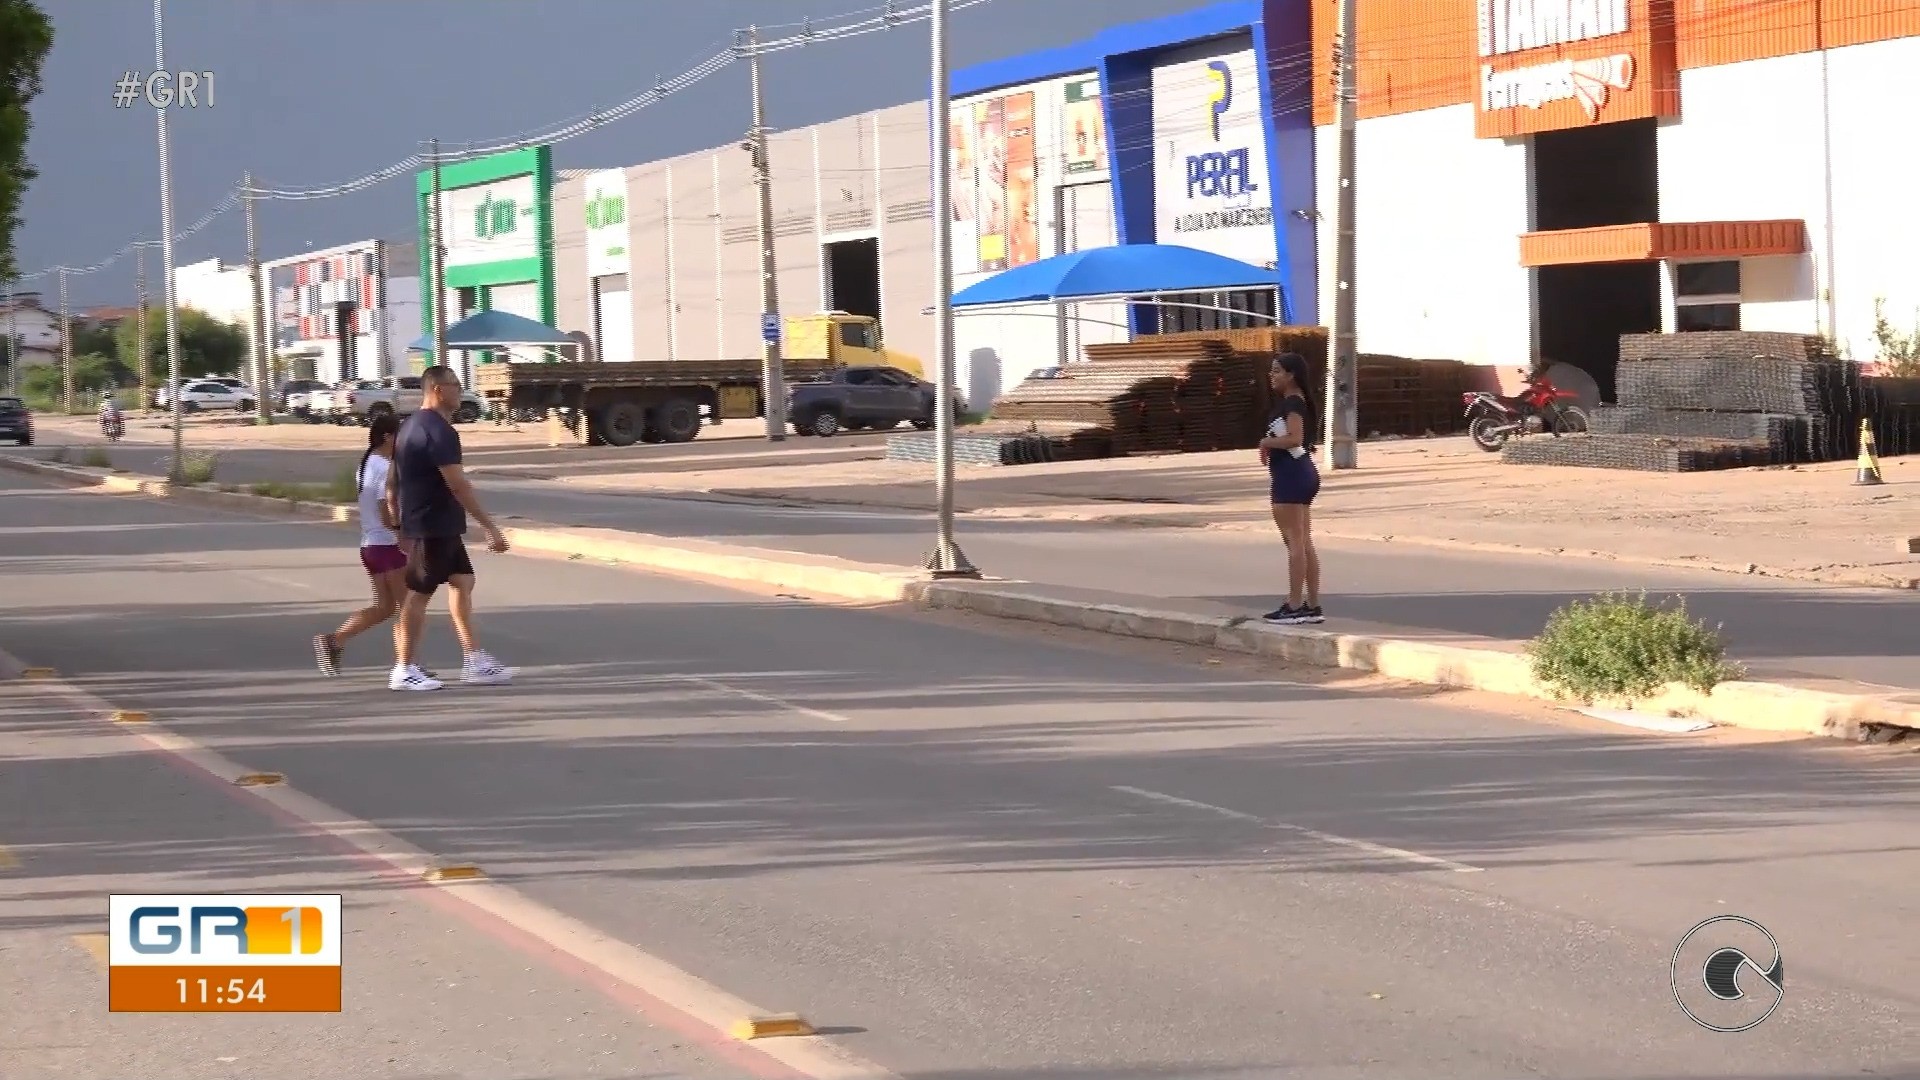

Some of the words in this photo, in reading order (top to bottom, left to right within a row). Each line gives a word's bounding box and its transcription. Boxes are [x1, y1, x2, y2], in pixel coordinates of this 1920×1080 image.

[1186, 146, 1258, 199] PERFIL
[1175, 215, 1182, 233] A
[1182, 211, 1205, 233] LOJA
[1205, 210, 1220, 230] DO
